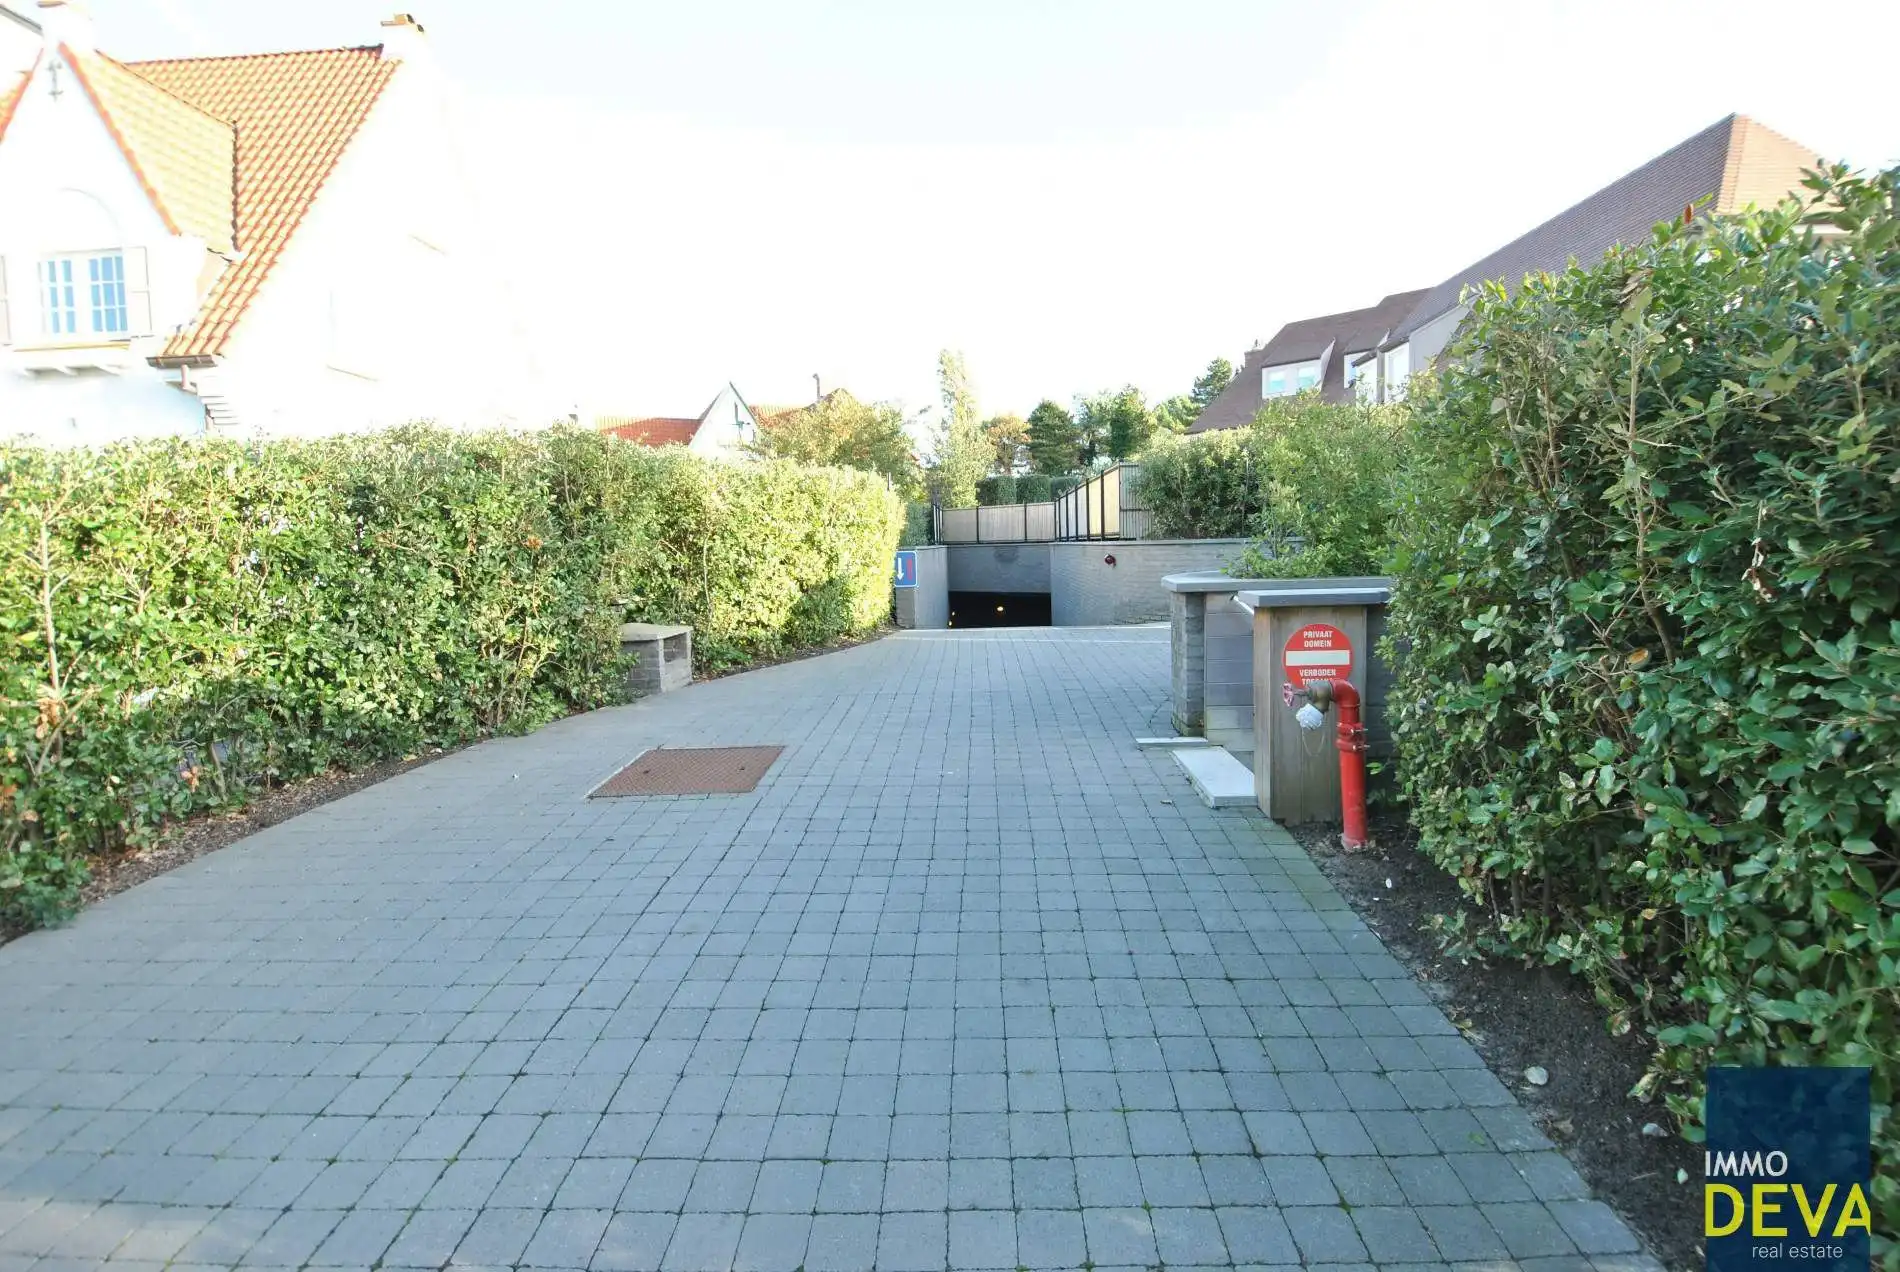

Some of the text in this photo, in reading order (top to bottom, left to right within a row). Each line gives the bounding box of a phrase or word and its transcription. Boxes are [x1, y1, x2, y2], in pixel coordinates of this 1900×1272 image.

[1303, 630, 1333, 638] PRIVAAT
[1303, 640, 1332, 648] DOMEIN
[1299, 669, 1337, 677] VERBODEN
